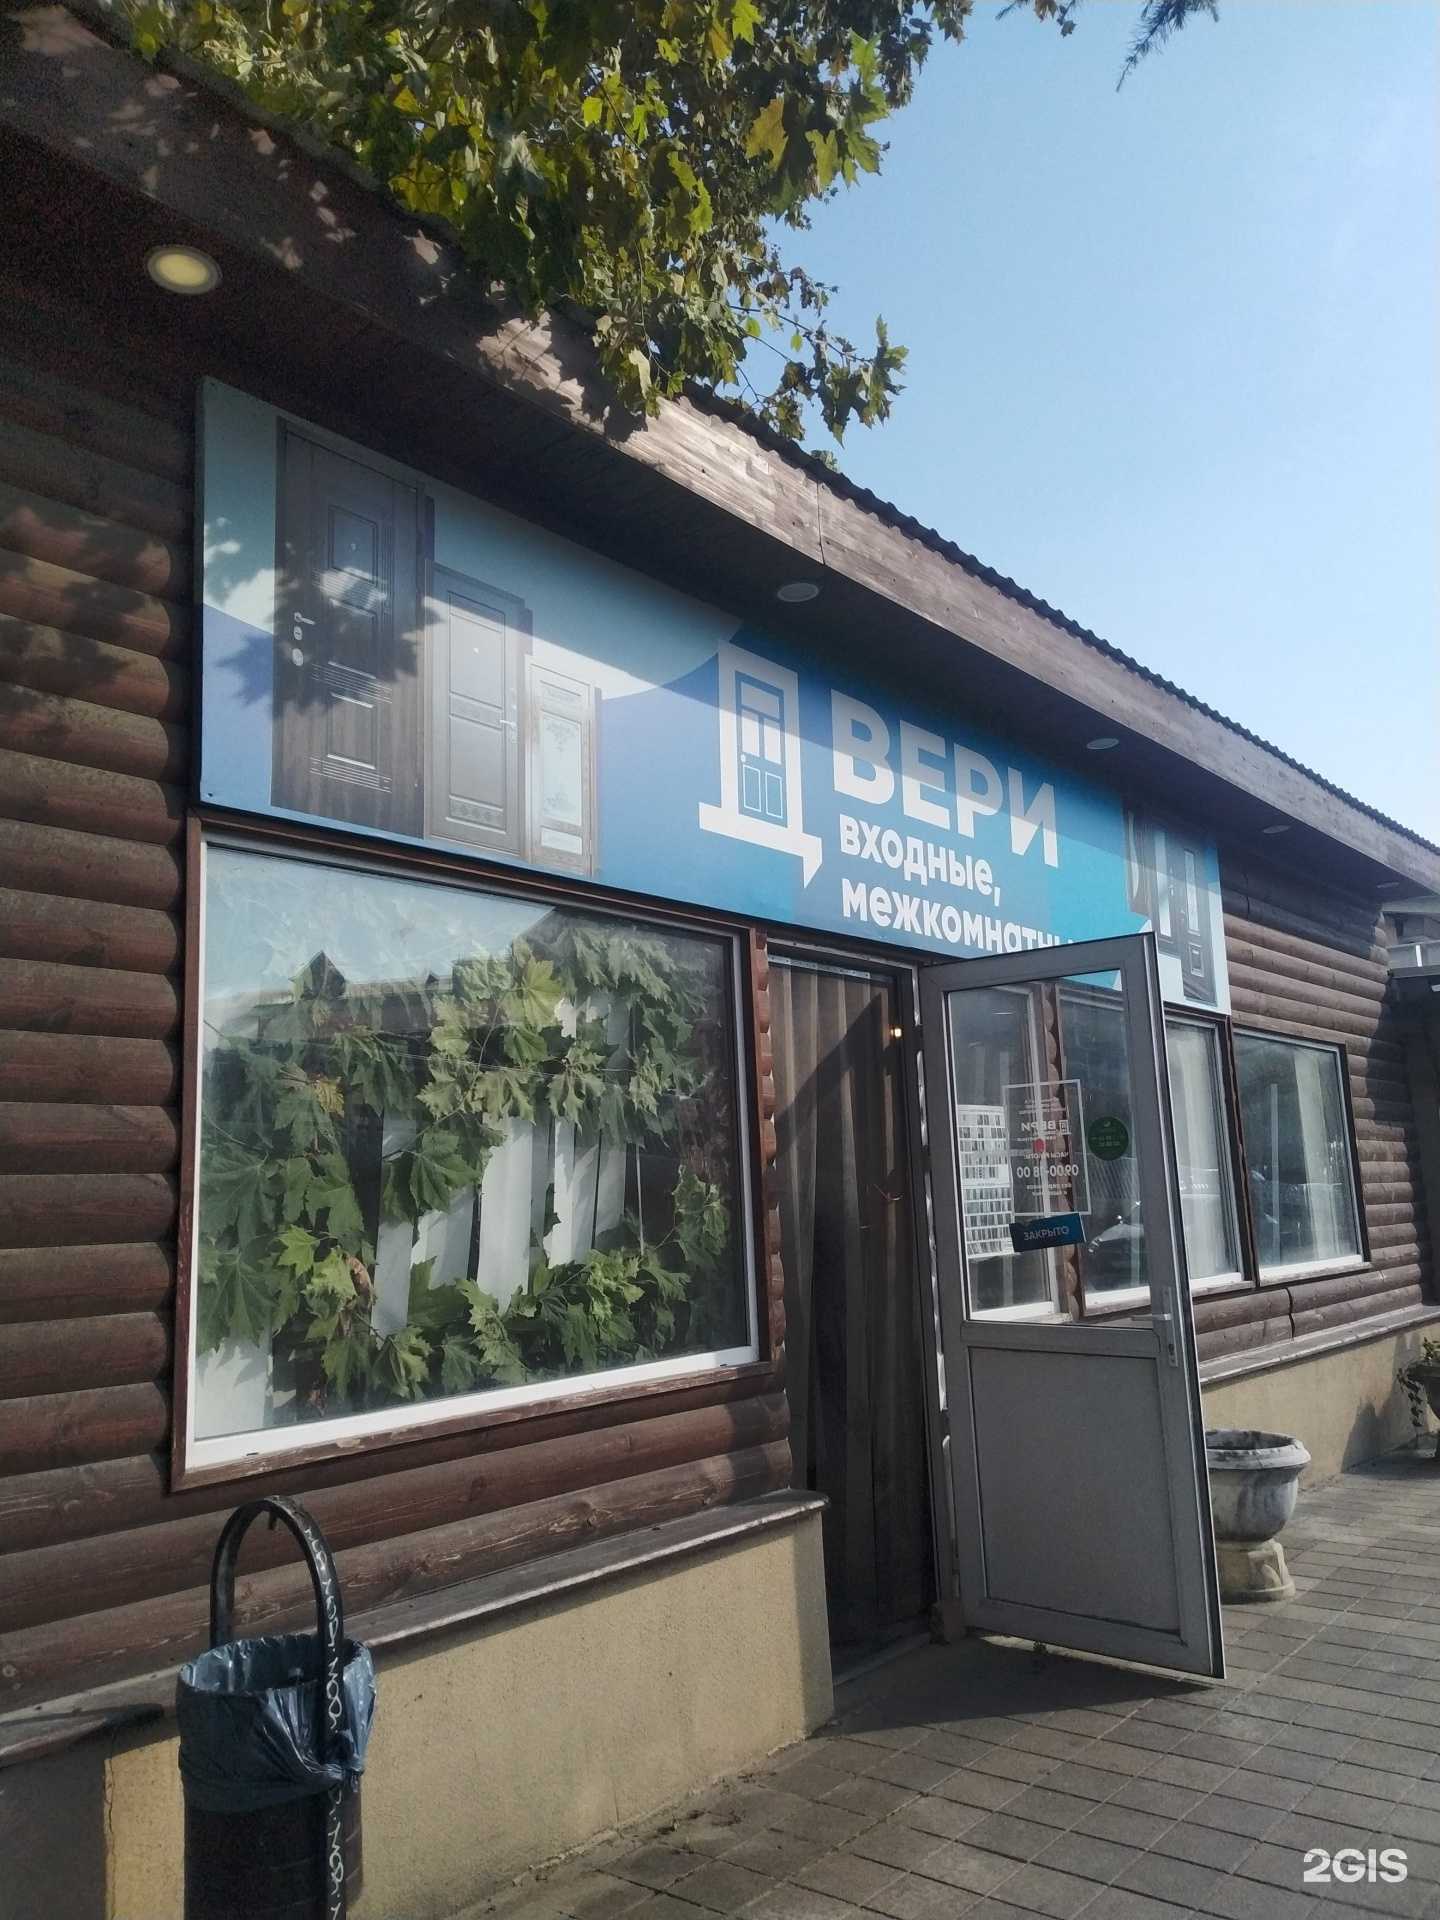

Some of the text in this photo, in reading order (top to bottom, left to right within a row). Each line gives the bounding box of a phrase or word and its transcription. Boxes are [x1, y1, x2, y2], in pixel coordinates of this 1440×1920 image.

[839, 813, 1001, 906] входные,
[841, 878, 1076, 954] межкомнатн
[1023, 1226, 1070, 1241] ЗАКРЫТО
